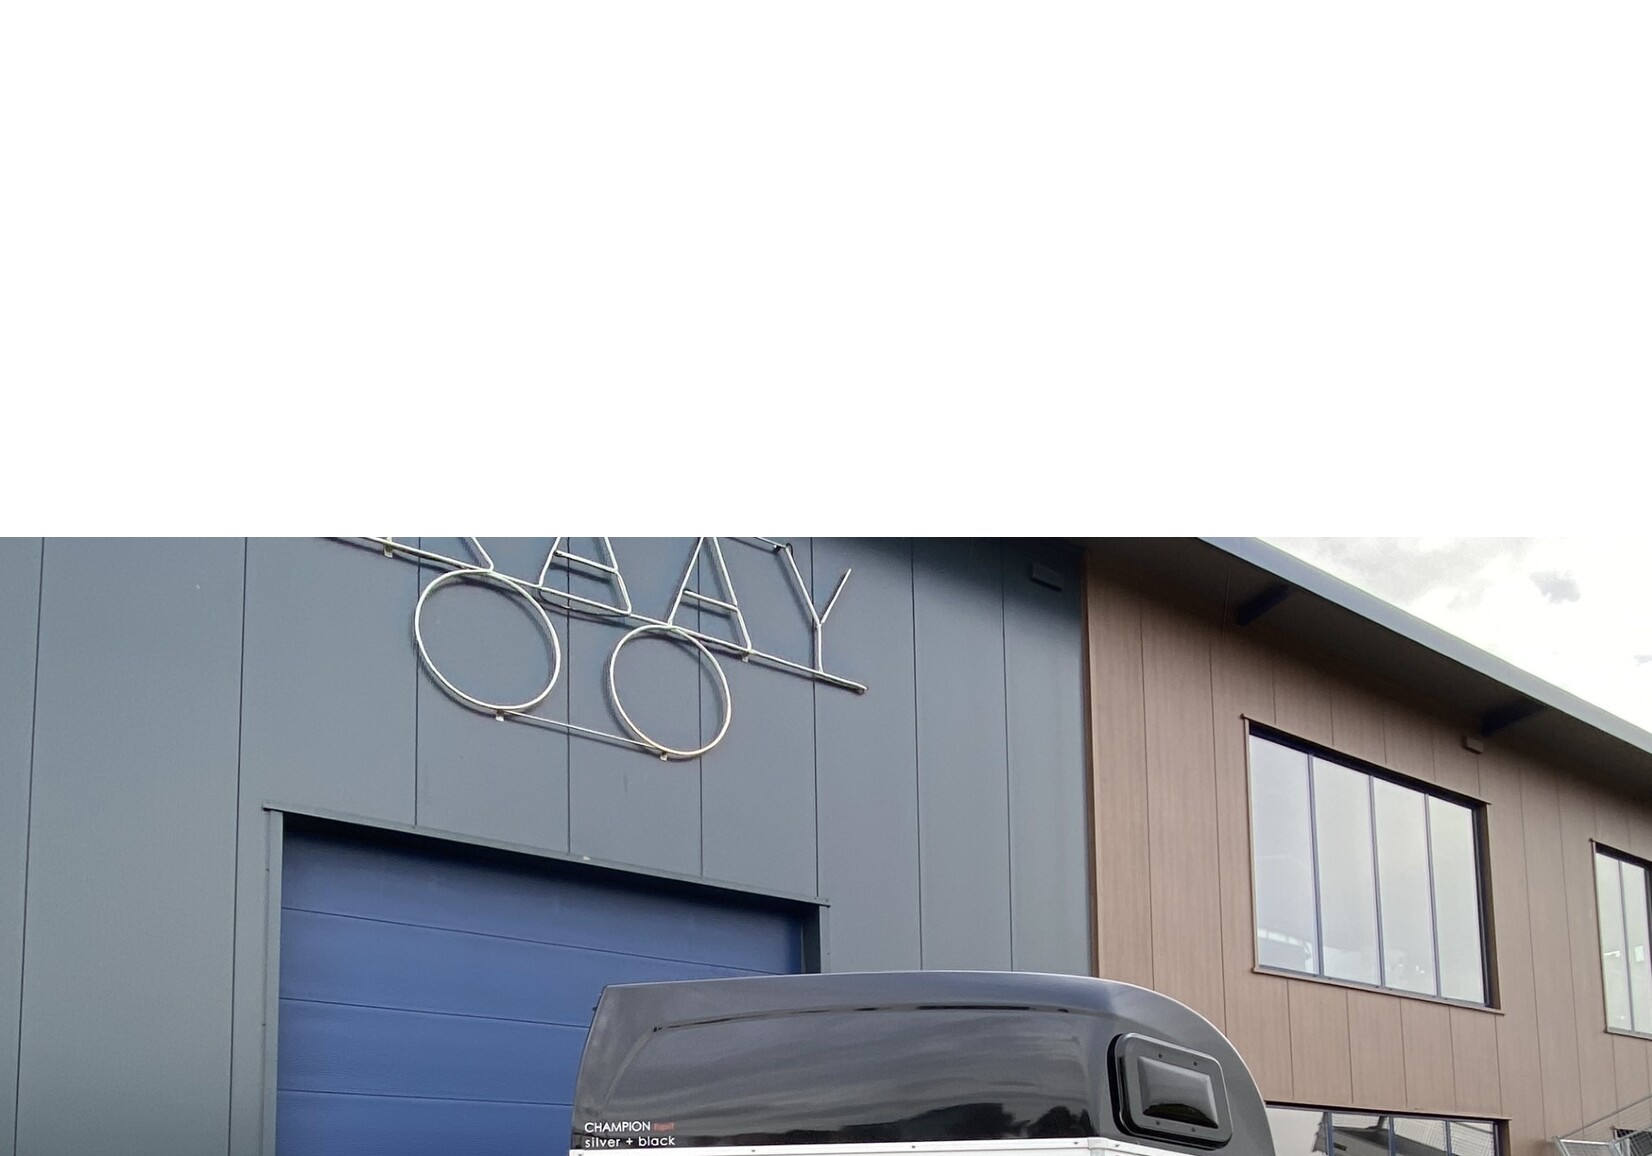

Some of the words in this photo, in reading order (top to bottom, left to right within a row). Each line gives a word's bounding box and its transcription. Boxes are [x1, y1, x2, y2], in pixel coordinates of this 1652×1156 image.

[584, 1121, 651, 1133] CHAMPION
[585, 1137, 621, 1148] silver
[638, 1136, 676, 1147] black
